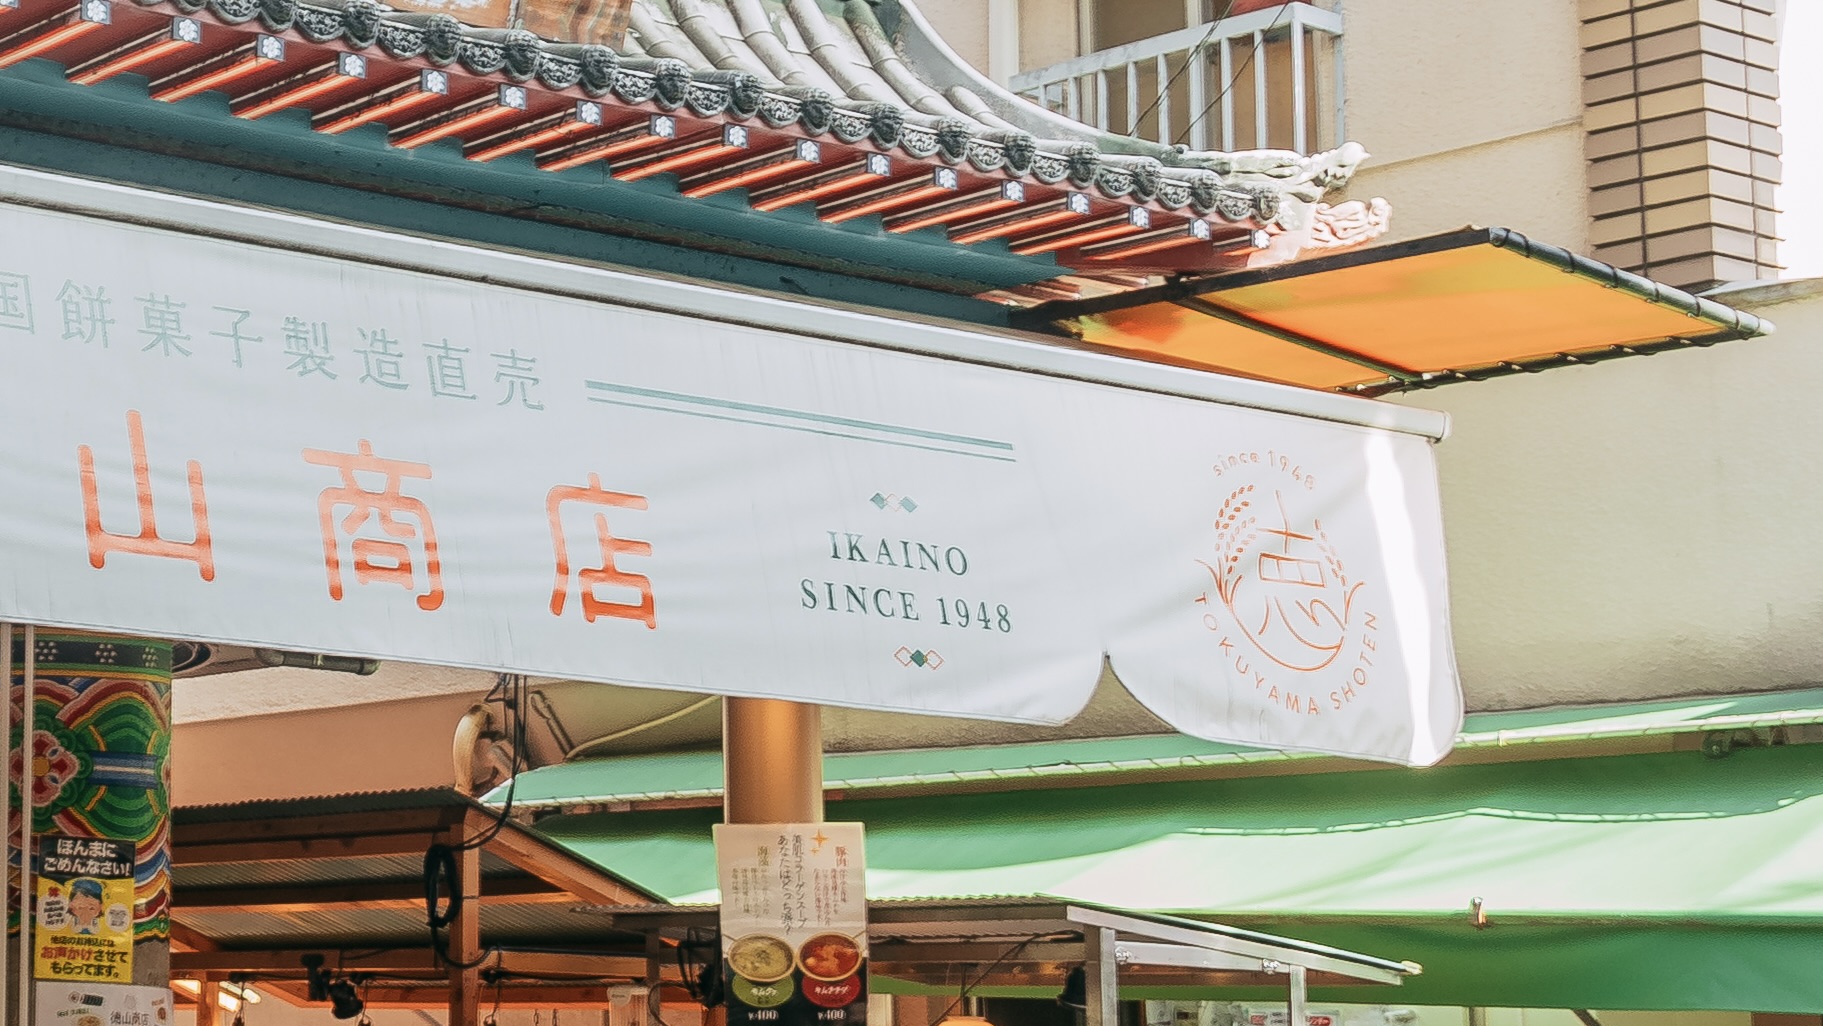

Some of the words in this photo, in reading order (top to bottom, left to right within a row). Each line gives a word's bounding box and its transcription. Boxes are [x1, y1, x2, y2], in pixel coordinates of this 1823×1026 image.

[1268, 450, 1316, 492] 1948
[827, 530, 970, 577] IKAINO
[800, 578, 920, 623] SINCE
[936, 595, 1013, 635] 1948
[1194, 591, 1322, 717] TOKUYAMA
[1330, 611, 1379, 711] SHOTEN
[56, 838, 118, 858] ほんまに
